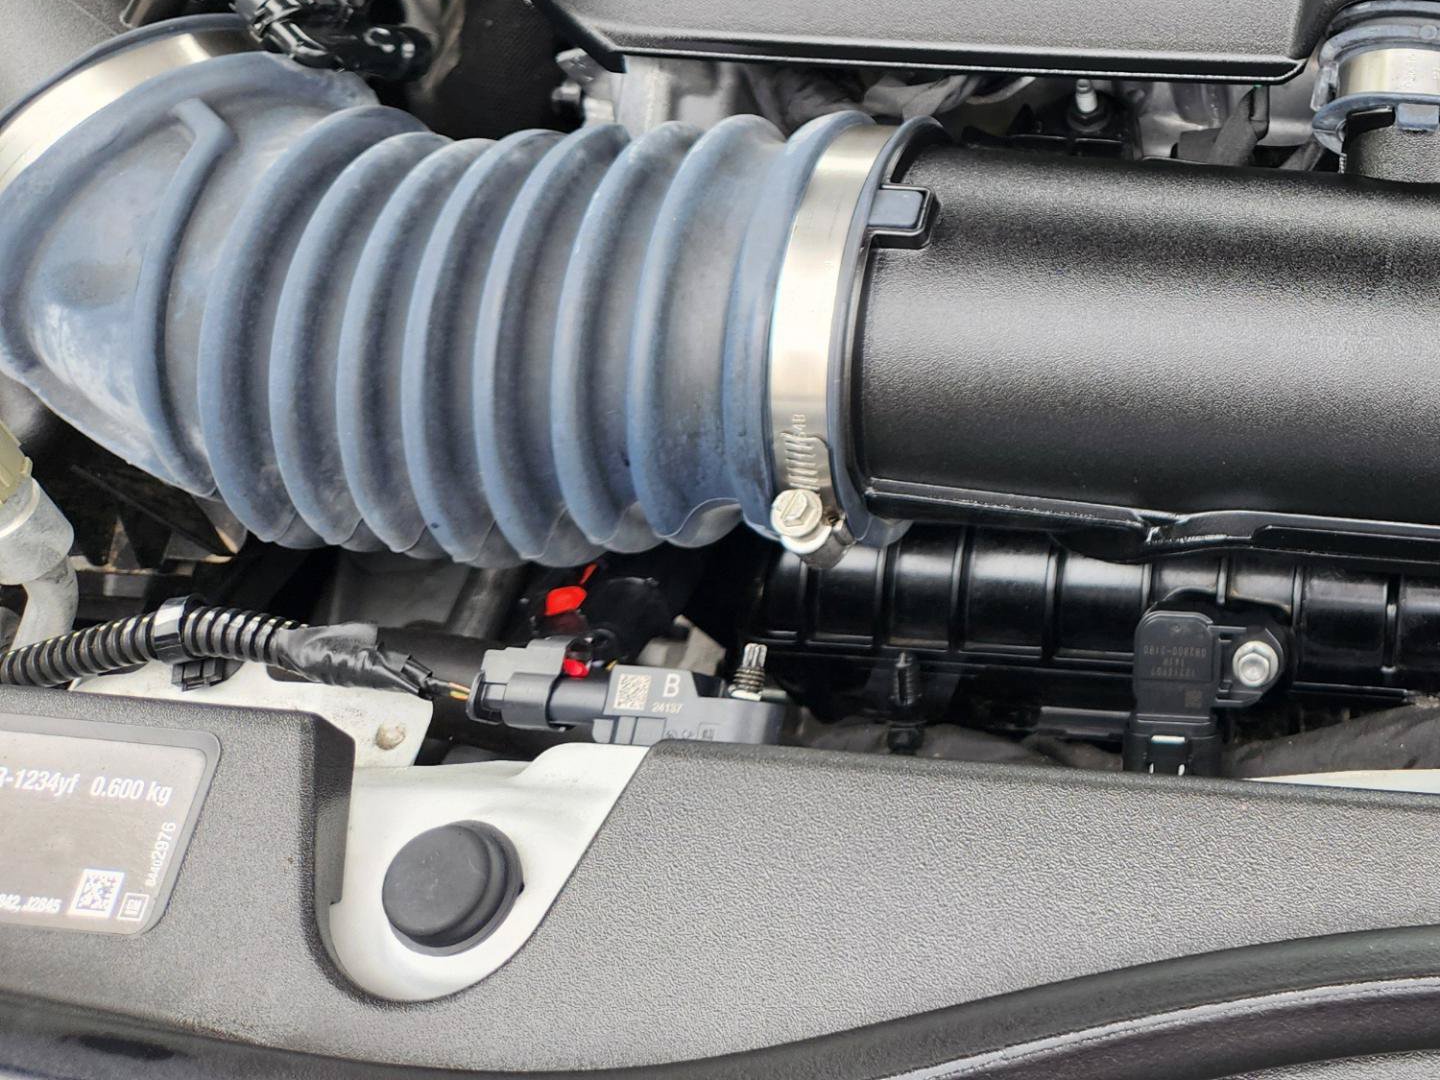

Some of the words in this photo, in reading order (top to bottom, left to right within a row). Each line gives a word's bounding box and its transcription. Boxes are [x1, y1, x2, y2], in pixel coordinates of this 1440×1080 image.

[662, 673, 681, 698] B
[90, 775, 144, 800] 0.600
[146, 781, 173, 807] kg
